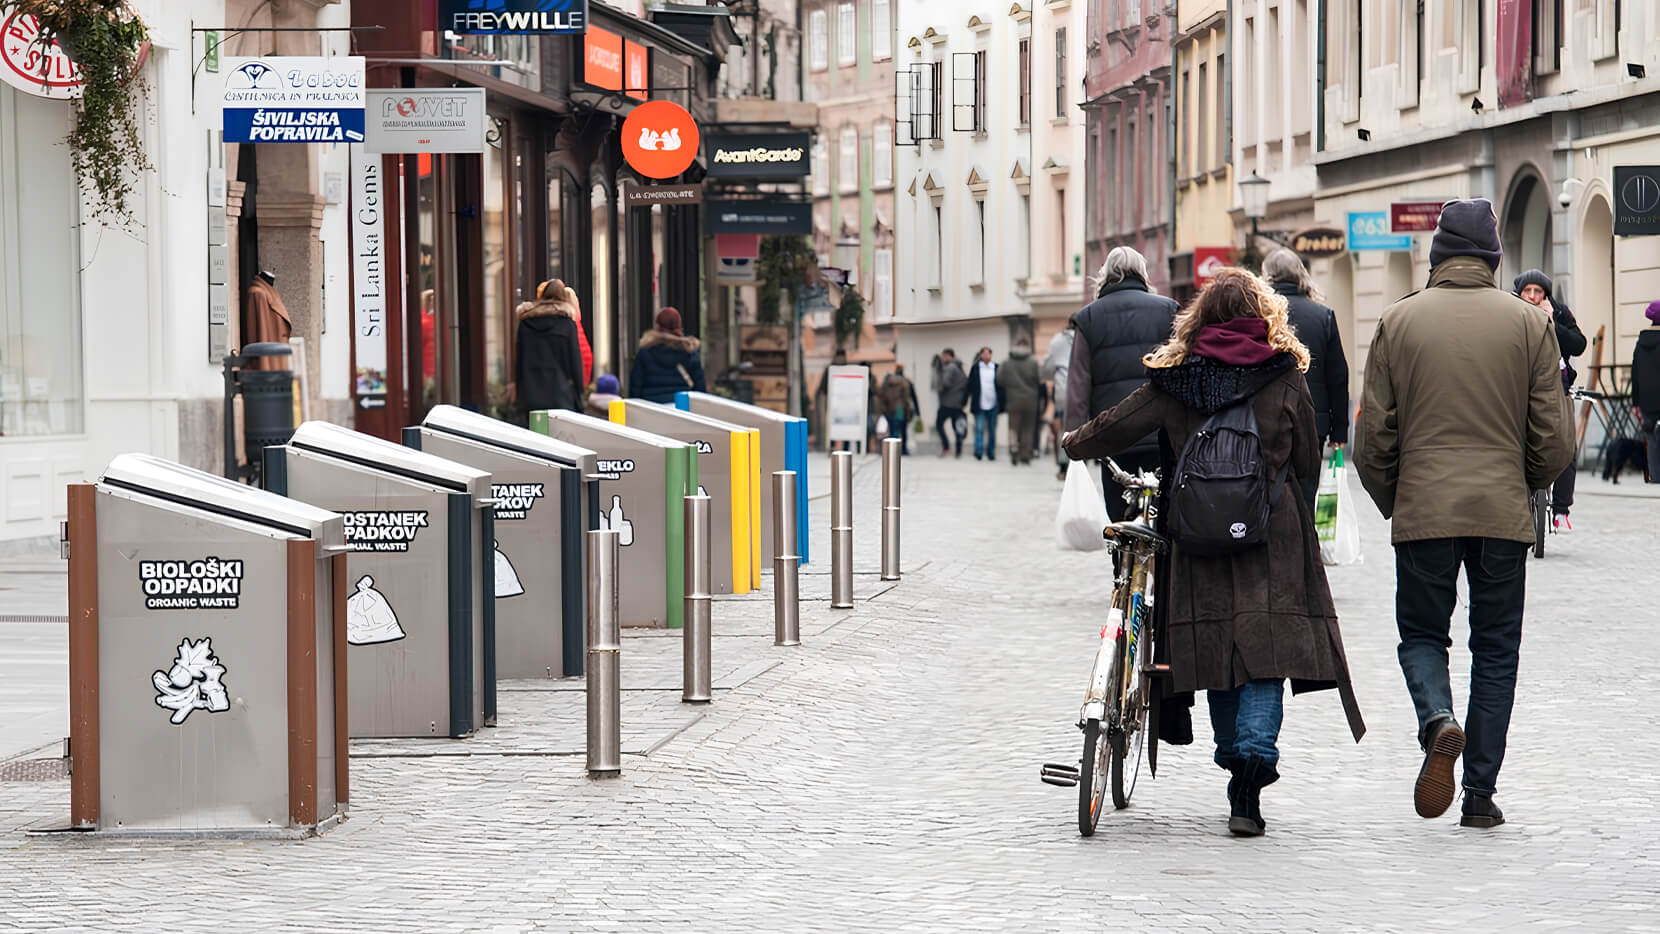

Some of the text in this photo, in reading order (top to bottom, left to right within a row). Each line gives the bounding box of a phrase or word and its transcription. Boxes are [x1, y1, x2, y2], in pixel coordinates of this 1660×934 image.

[453, 12, 583, 30] FREYWILLE
[289, 92, 301, 101] IN
[382, 97, 467, 118] POSVET
[252, 109, 340, 125] ŠIVILJSKA
[249, 126, 344, 141] POPRAVILA
[358, 164, 381, 337] Sri Lanka Gems
[597, 460, 634, 472] EKLO
[494, 497, 534, 509] KOV
[343, 511, 428, 527] OSTANEK
[496, 511, 526, 519] WASTE
[344, 526, 417, 540] PADKOV
[374, 542, 408, 551] WASTE
[141, 558, 242, 579] BIOLOŠKI
[144, 578, 239, 595] ODPADKI
[147, 598, 237, 608] ORGANIC WASTE
